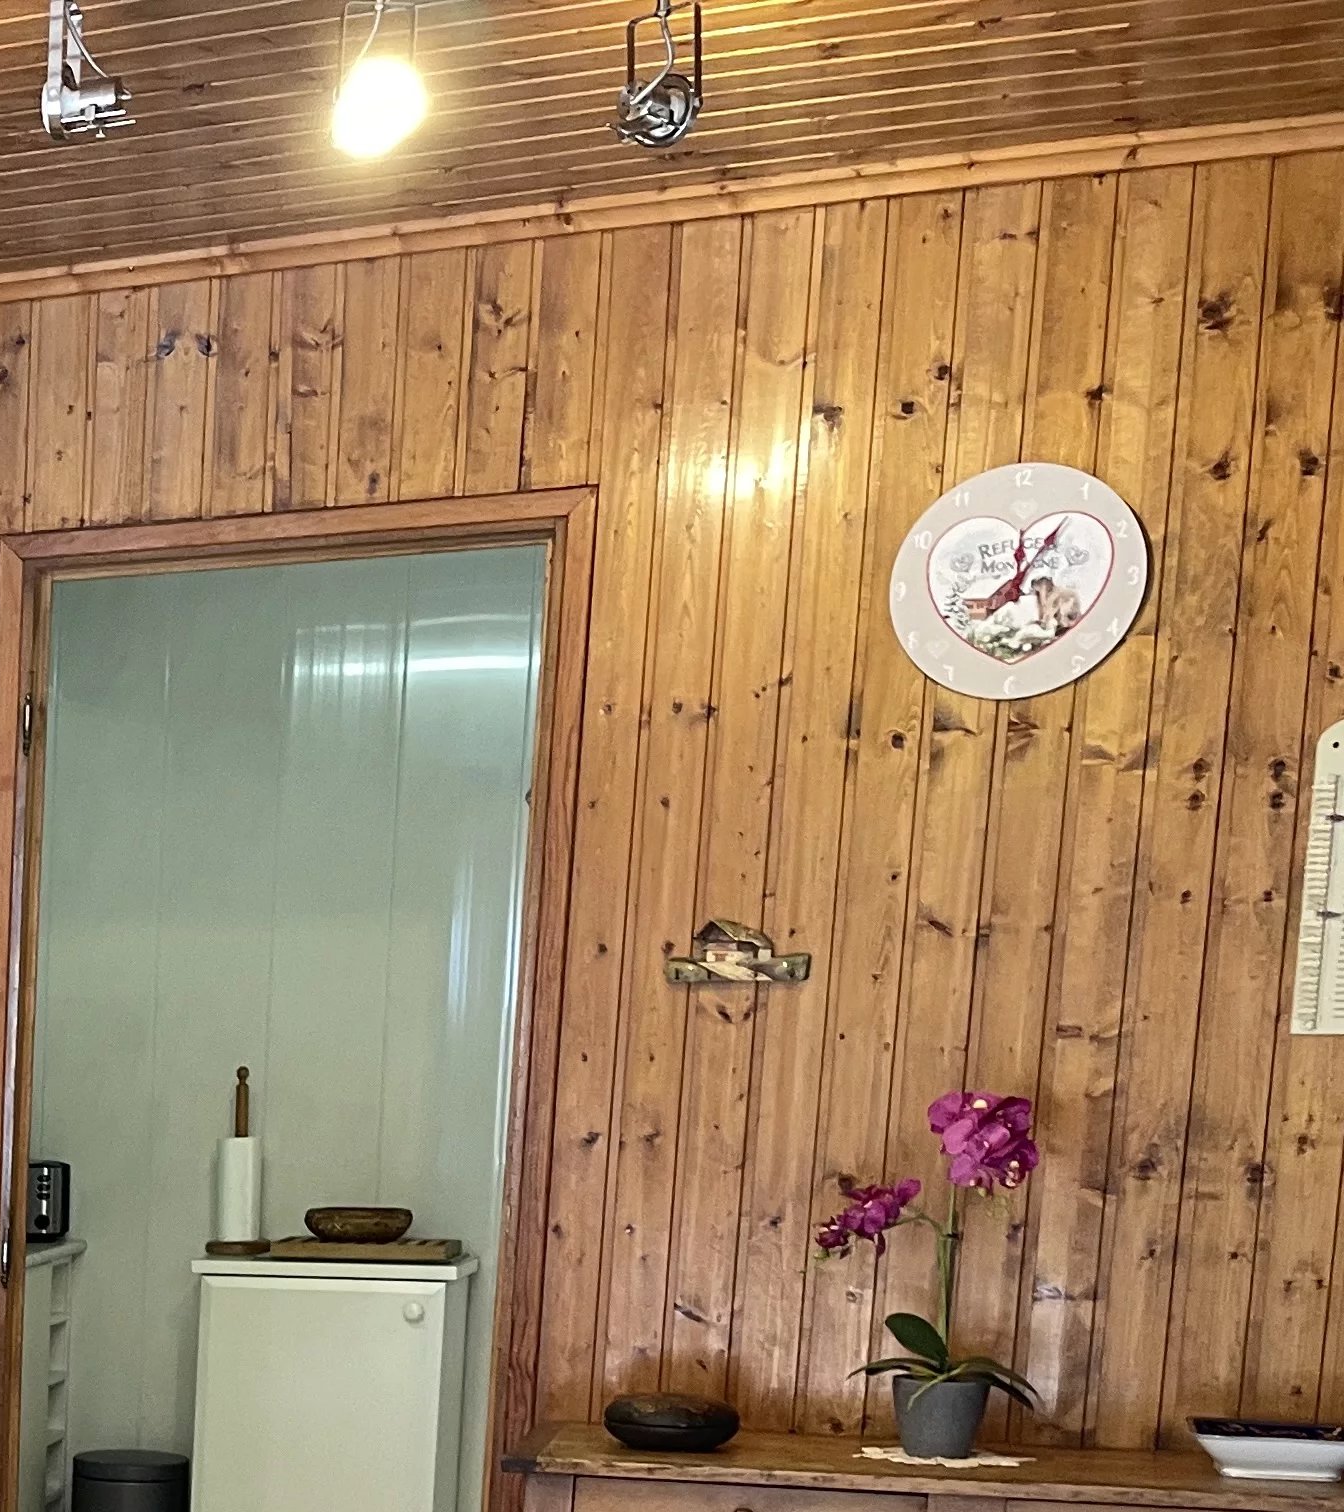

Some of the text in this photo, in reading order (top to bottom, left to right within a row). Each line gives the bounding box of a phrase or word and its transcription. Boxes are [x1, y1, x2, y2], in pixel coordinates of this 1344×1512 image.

[1014, 470, 1032, 488] 12
[952, 491, 970, 507] 11
[1080, 482, 1090, 500] 1
[1116, 519, 1129, 537] 2
[913, 530, 933, 549] 10
[979, 556, 1060, 574] MONGNE
[1127, 566, 1140, 585] 3
[895, 581, 907, 602] 9
[1105, 618, 1119, 637] 4
[943, 664, 955, 681] 7
[1071, 655, 1086, 674] 5
